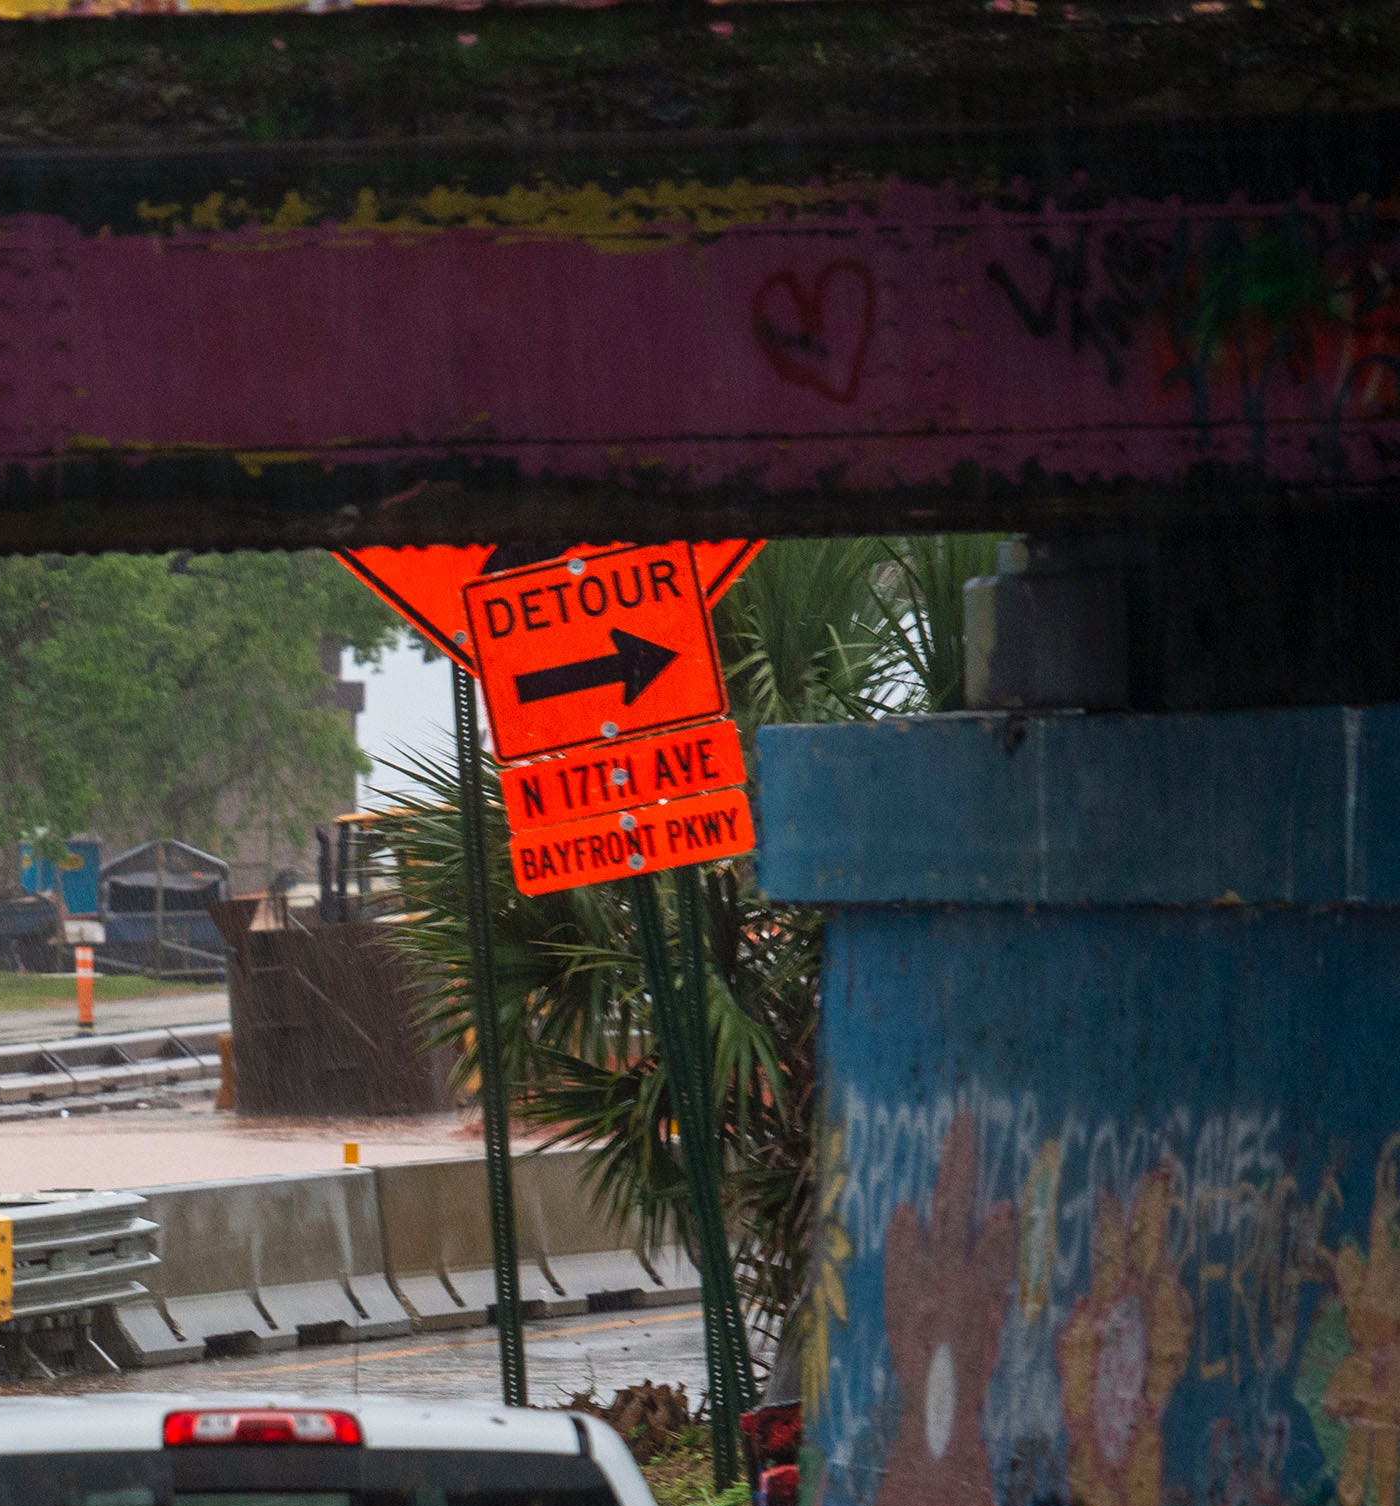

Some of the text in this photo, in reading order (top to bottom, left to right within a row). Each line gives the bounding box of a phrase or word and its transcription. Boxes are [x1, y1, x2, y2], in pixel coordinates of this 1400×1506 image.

[485, 559, 683, 640] DETOUR
[520, 739, 720, 818] N 17TH AVE
[520, 807, 740, 881] BAYFRONT PKWY
